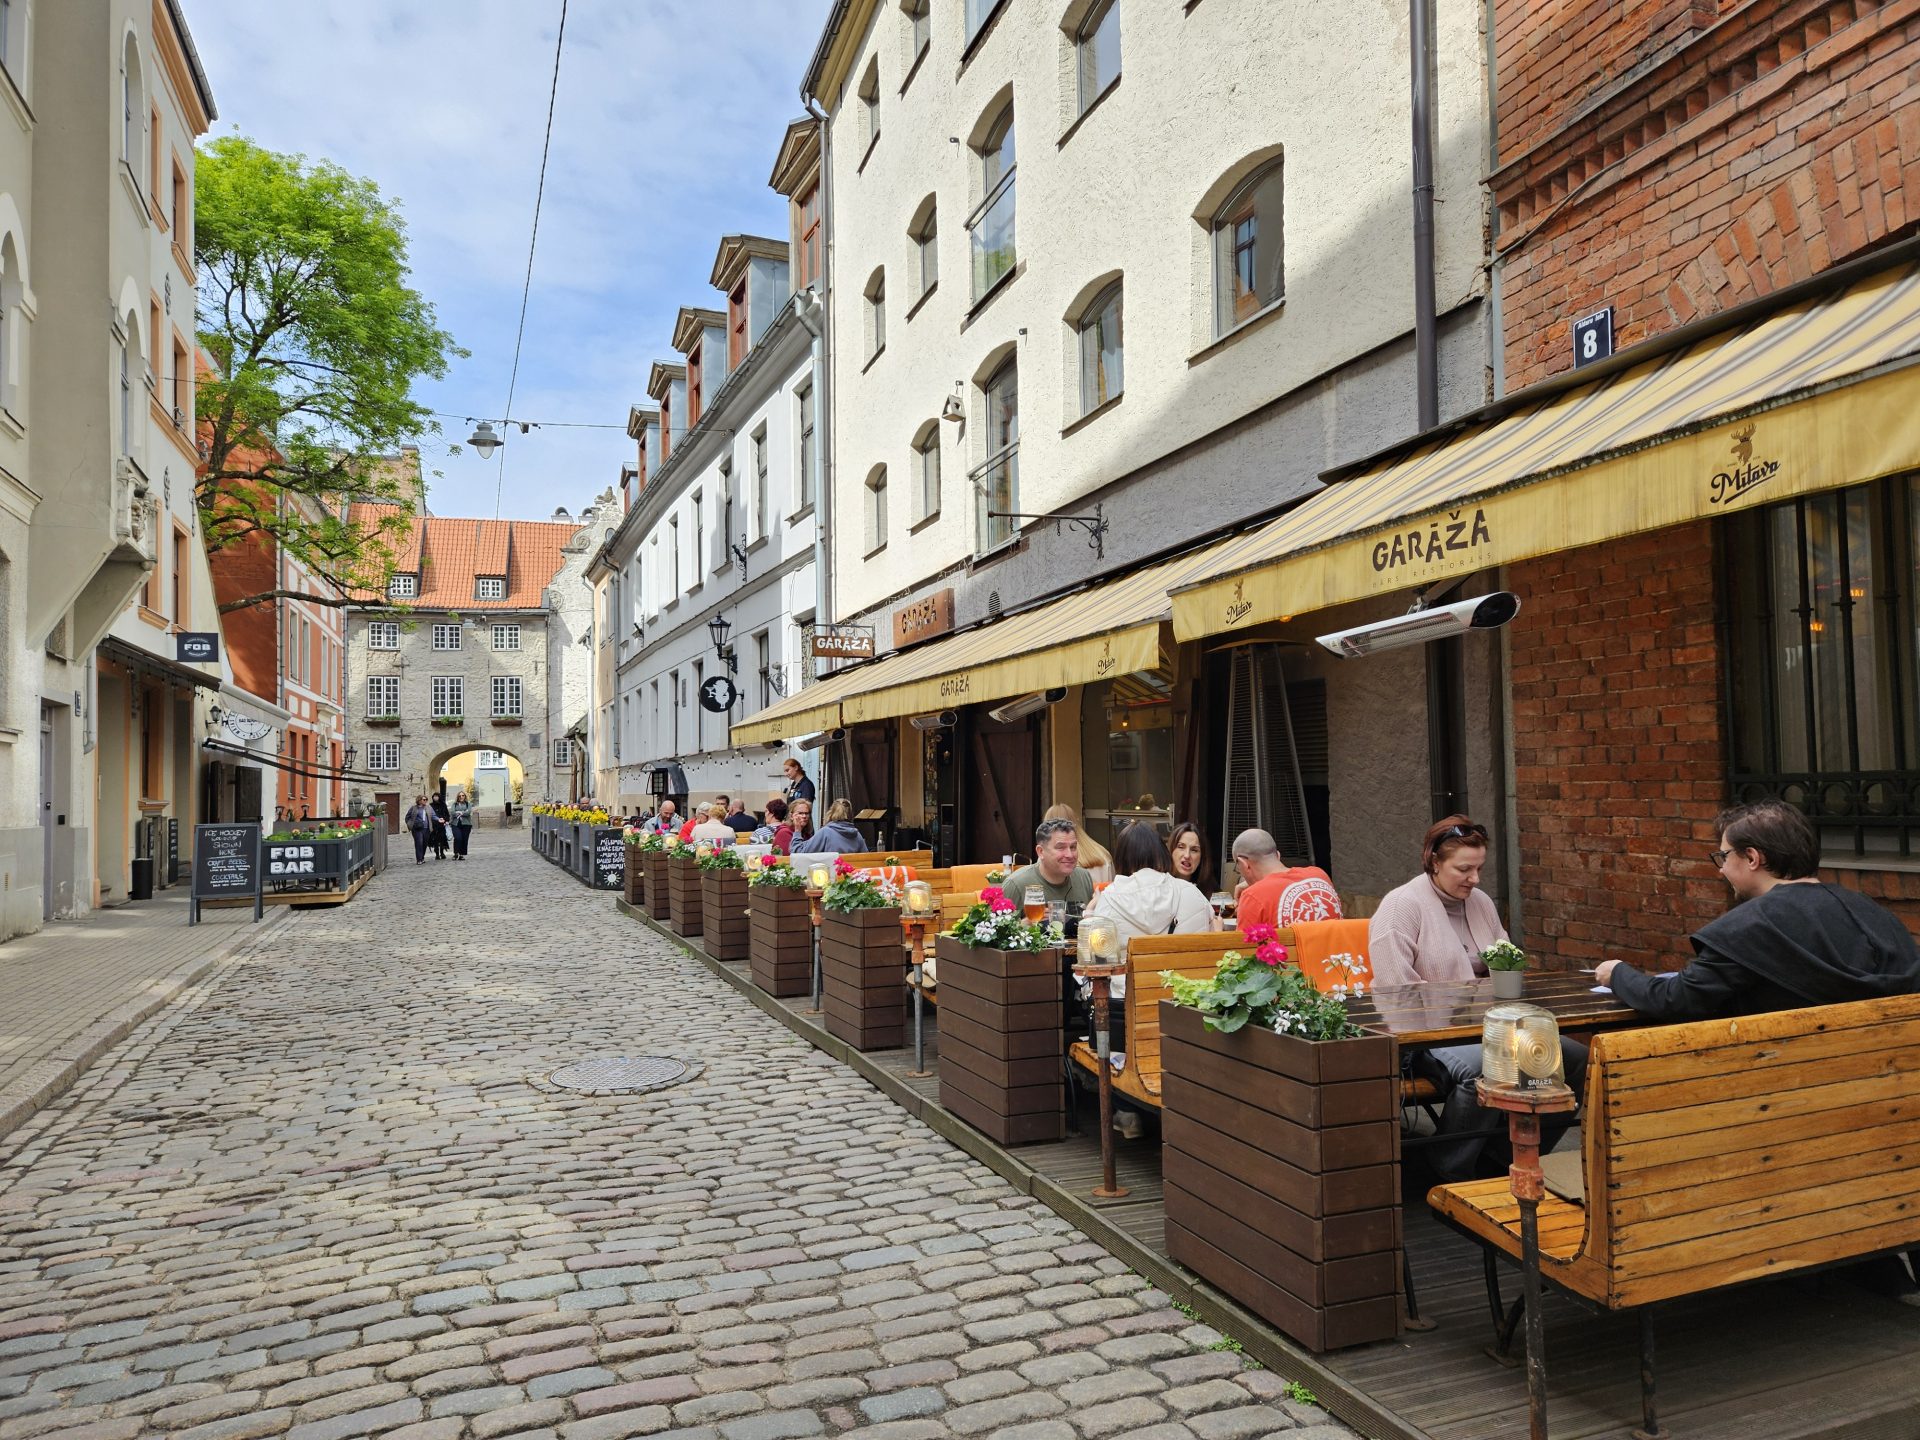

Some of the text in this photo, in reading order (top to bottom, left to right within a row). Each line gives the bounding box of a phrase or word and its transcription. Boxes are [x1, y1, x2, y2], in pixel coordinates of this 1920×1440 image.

[1583, 329, 1597, 359] 8
[1710, 460, 1781, 504] Mitava
[1372, 509, 1491, 572] GARĀŽA
[184, 643, 211, 651] FOB
[270, 846, 315, 859] FOB
[270, 861, 315, 875] BAR
